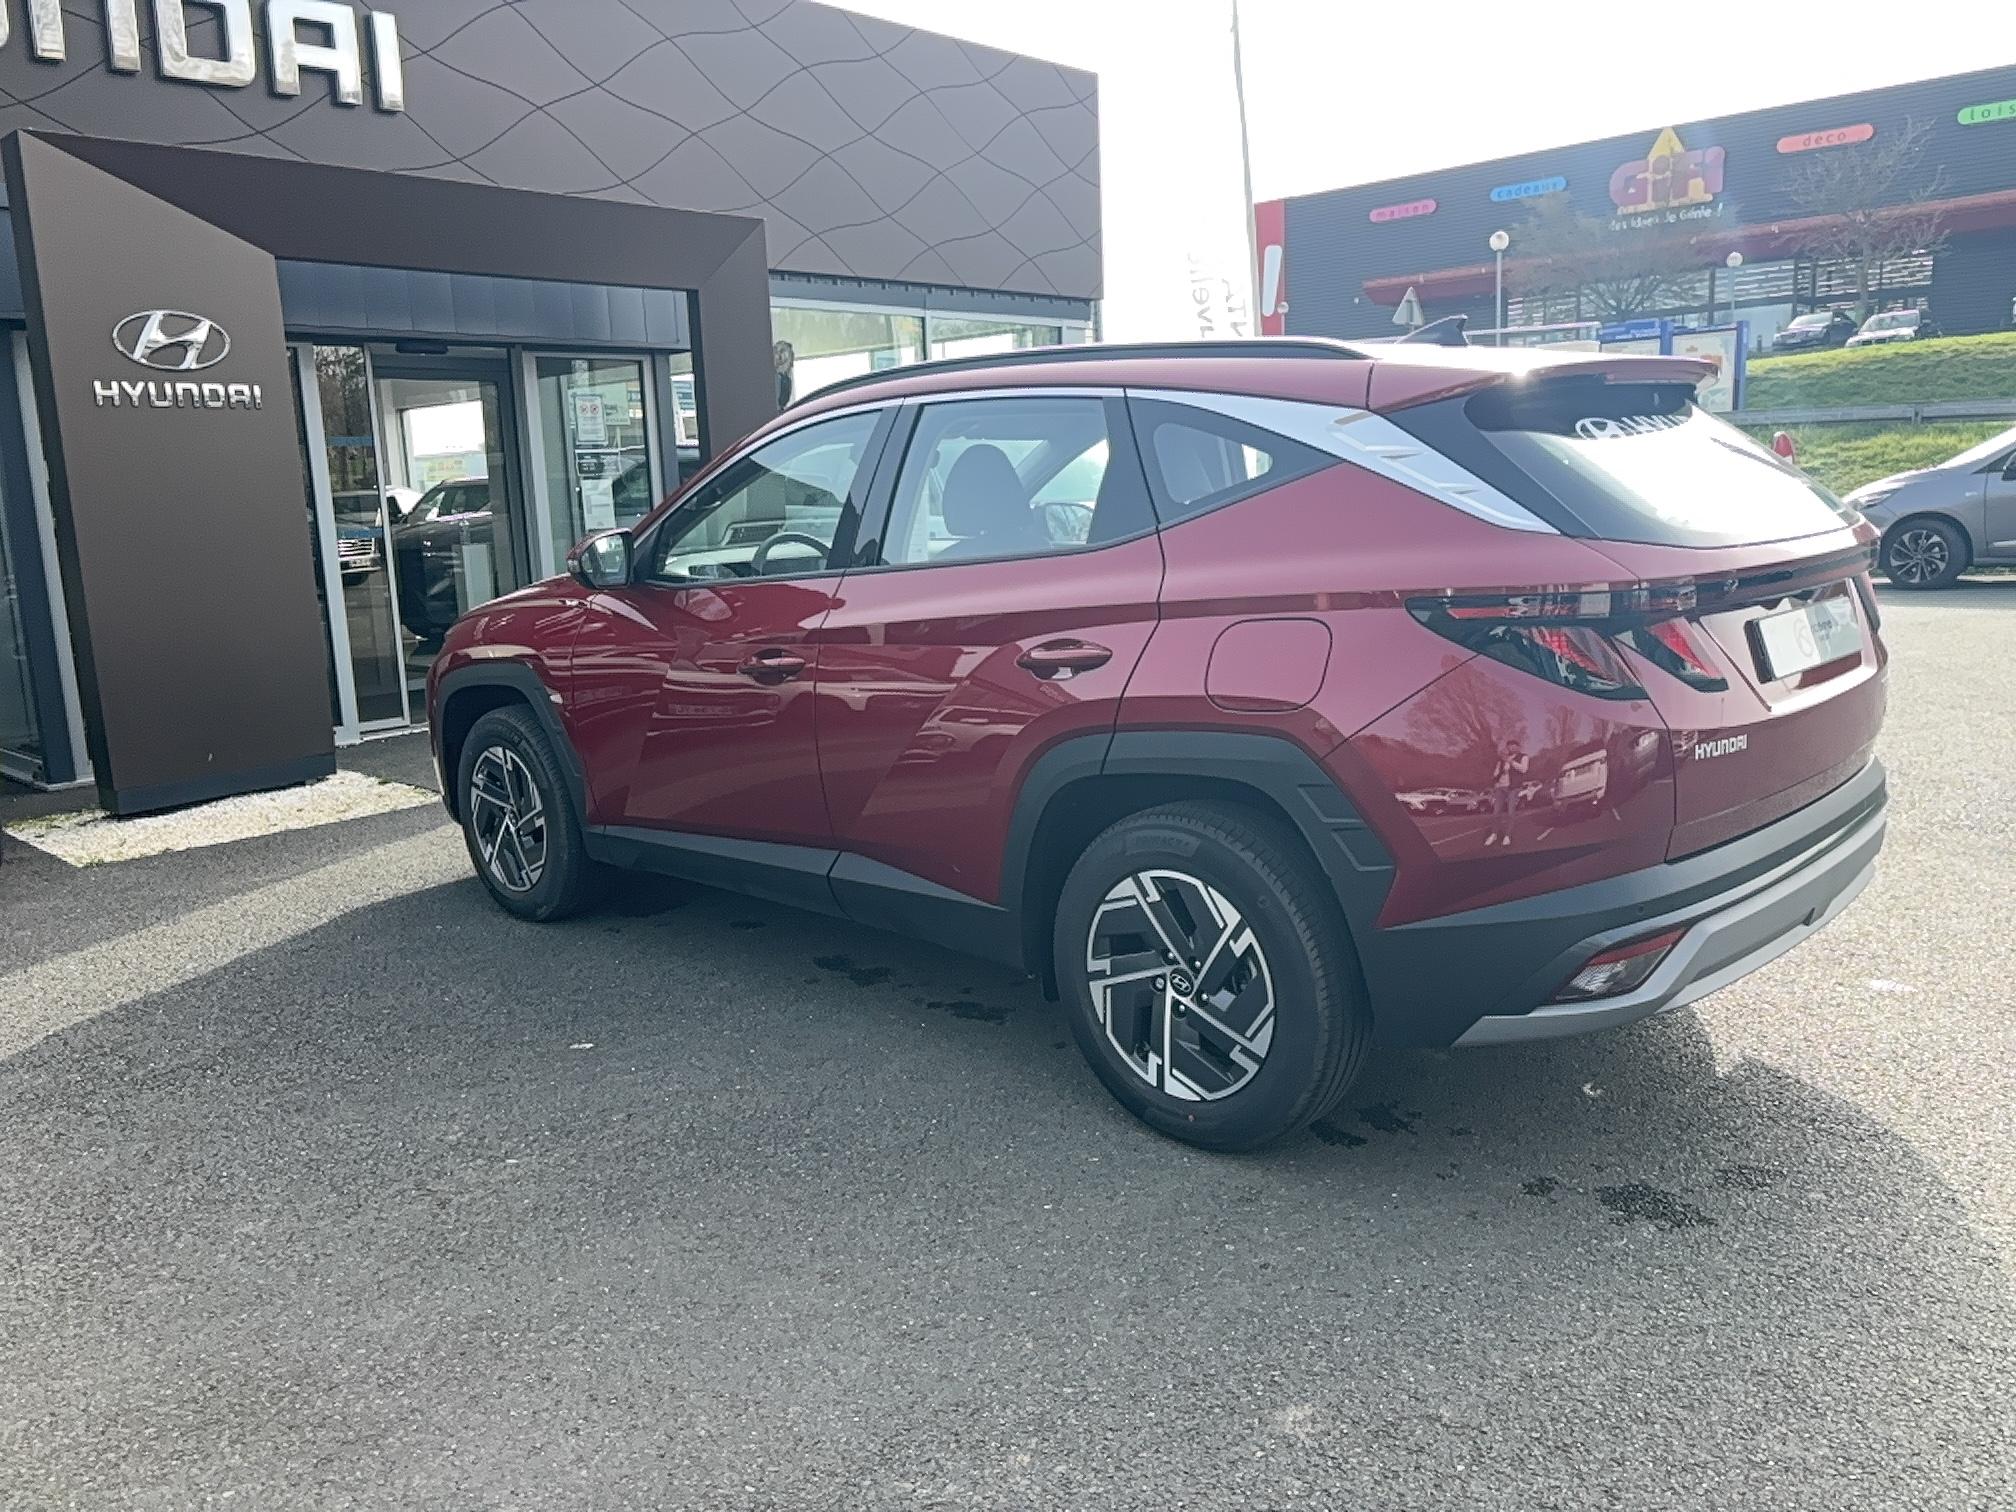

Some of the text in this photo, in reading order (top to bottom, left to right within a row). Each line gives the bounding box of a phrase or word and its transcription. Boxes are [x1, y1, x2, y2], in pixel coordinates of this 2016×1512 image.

[1803, 132, 1847, 147] deco
[93, 380, 263, 410] HYUNDAI
[1695, 733, 1748, 761] HYUNDAI
